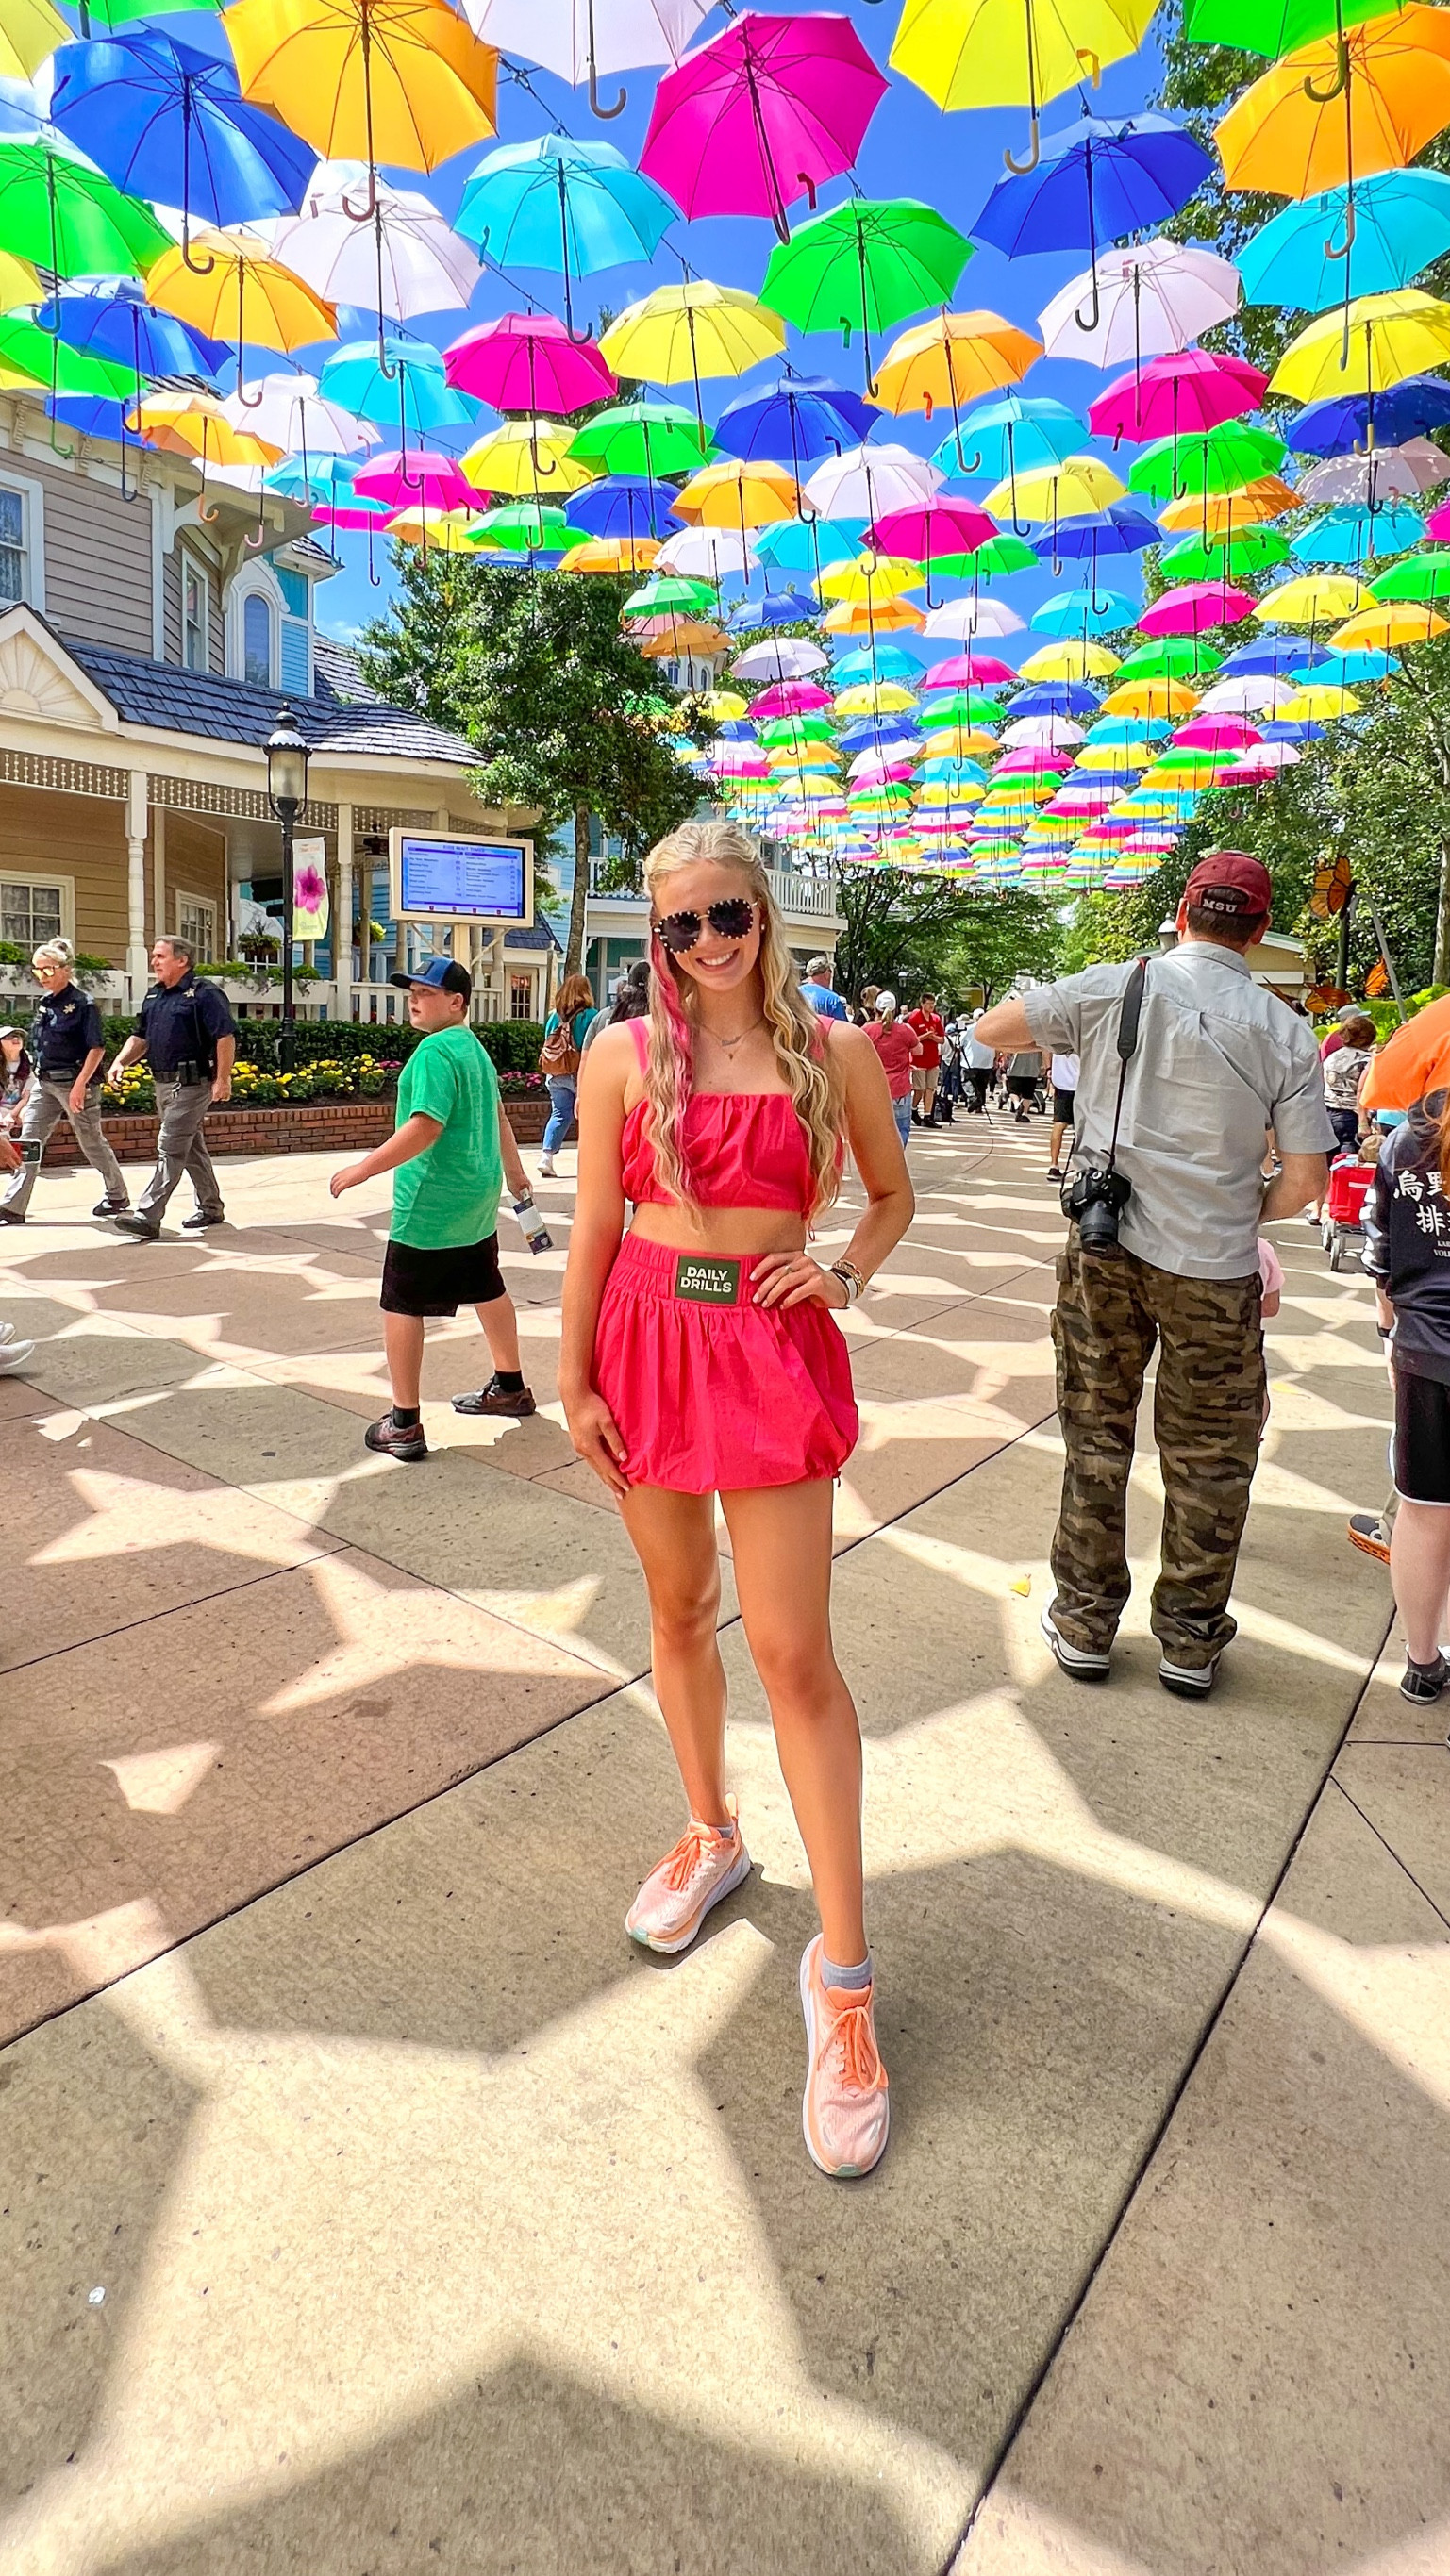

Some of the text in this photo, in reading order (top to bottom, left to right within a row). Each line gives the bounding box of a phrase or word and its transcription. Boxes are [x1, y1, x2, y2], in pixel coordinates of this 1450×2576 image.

[1202, 898, 1238, 913] MSU
[1415, 1204, 1450, 1237] 排
[687, 1266, 728, 1281] DAILY
[680, 1276, 732, 1293] DRILLS
